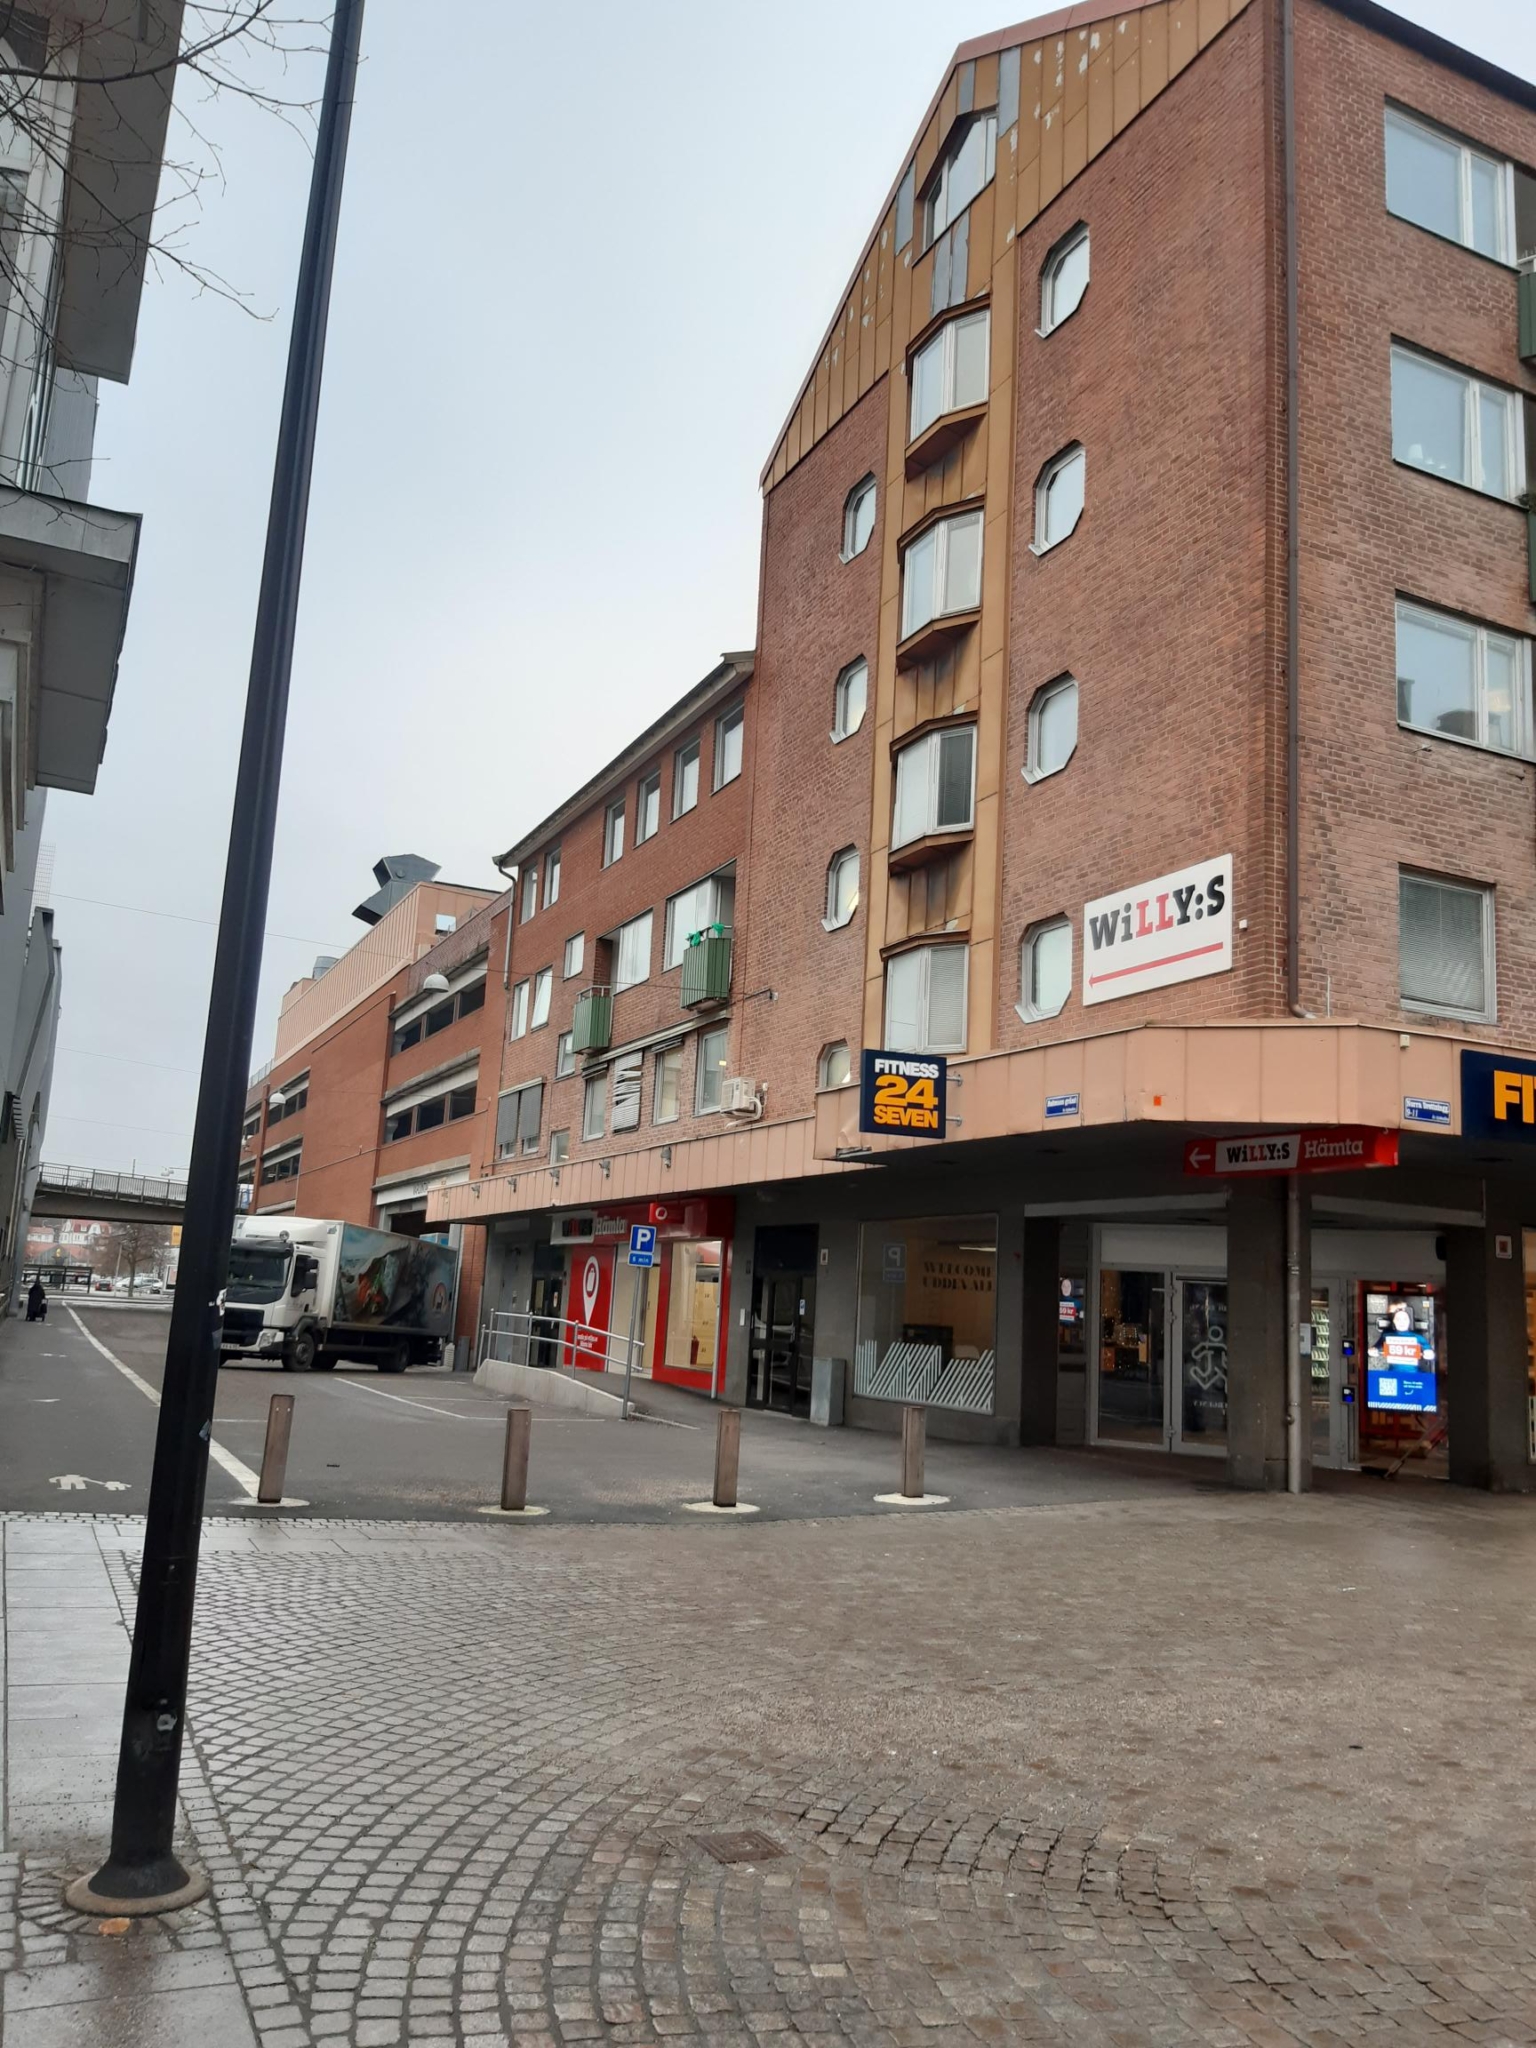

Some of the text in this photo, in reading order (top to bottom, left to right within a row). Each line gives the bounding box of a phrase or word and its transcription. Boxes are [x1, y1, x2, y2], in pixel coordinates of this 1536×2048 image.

[874, 1058, 939, 1079] FITNESS
[874, 1074, 939, 1109] 24
[1494, 1069, 1536, 1124] FI
[873, 1105, 939, 1129] SEVEN
[1304, 1139, 1364, 1159] Hämta
[595, 1215, 627, 1235] Hämta
[637, 1228, 652, 1250] P
[1404, 1345, 1416, 1357] kr
